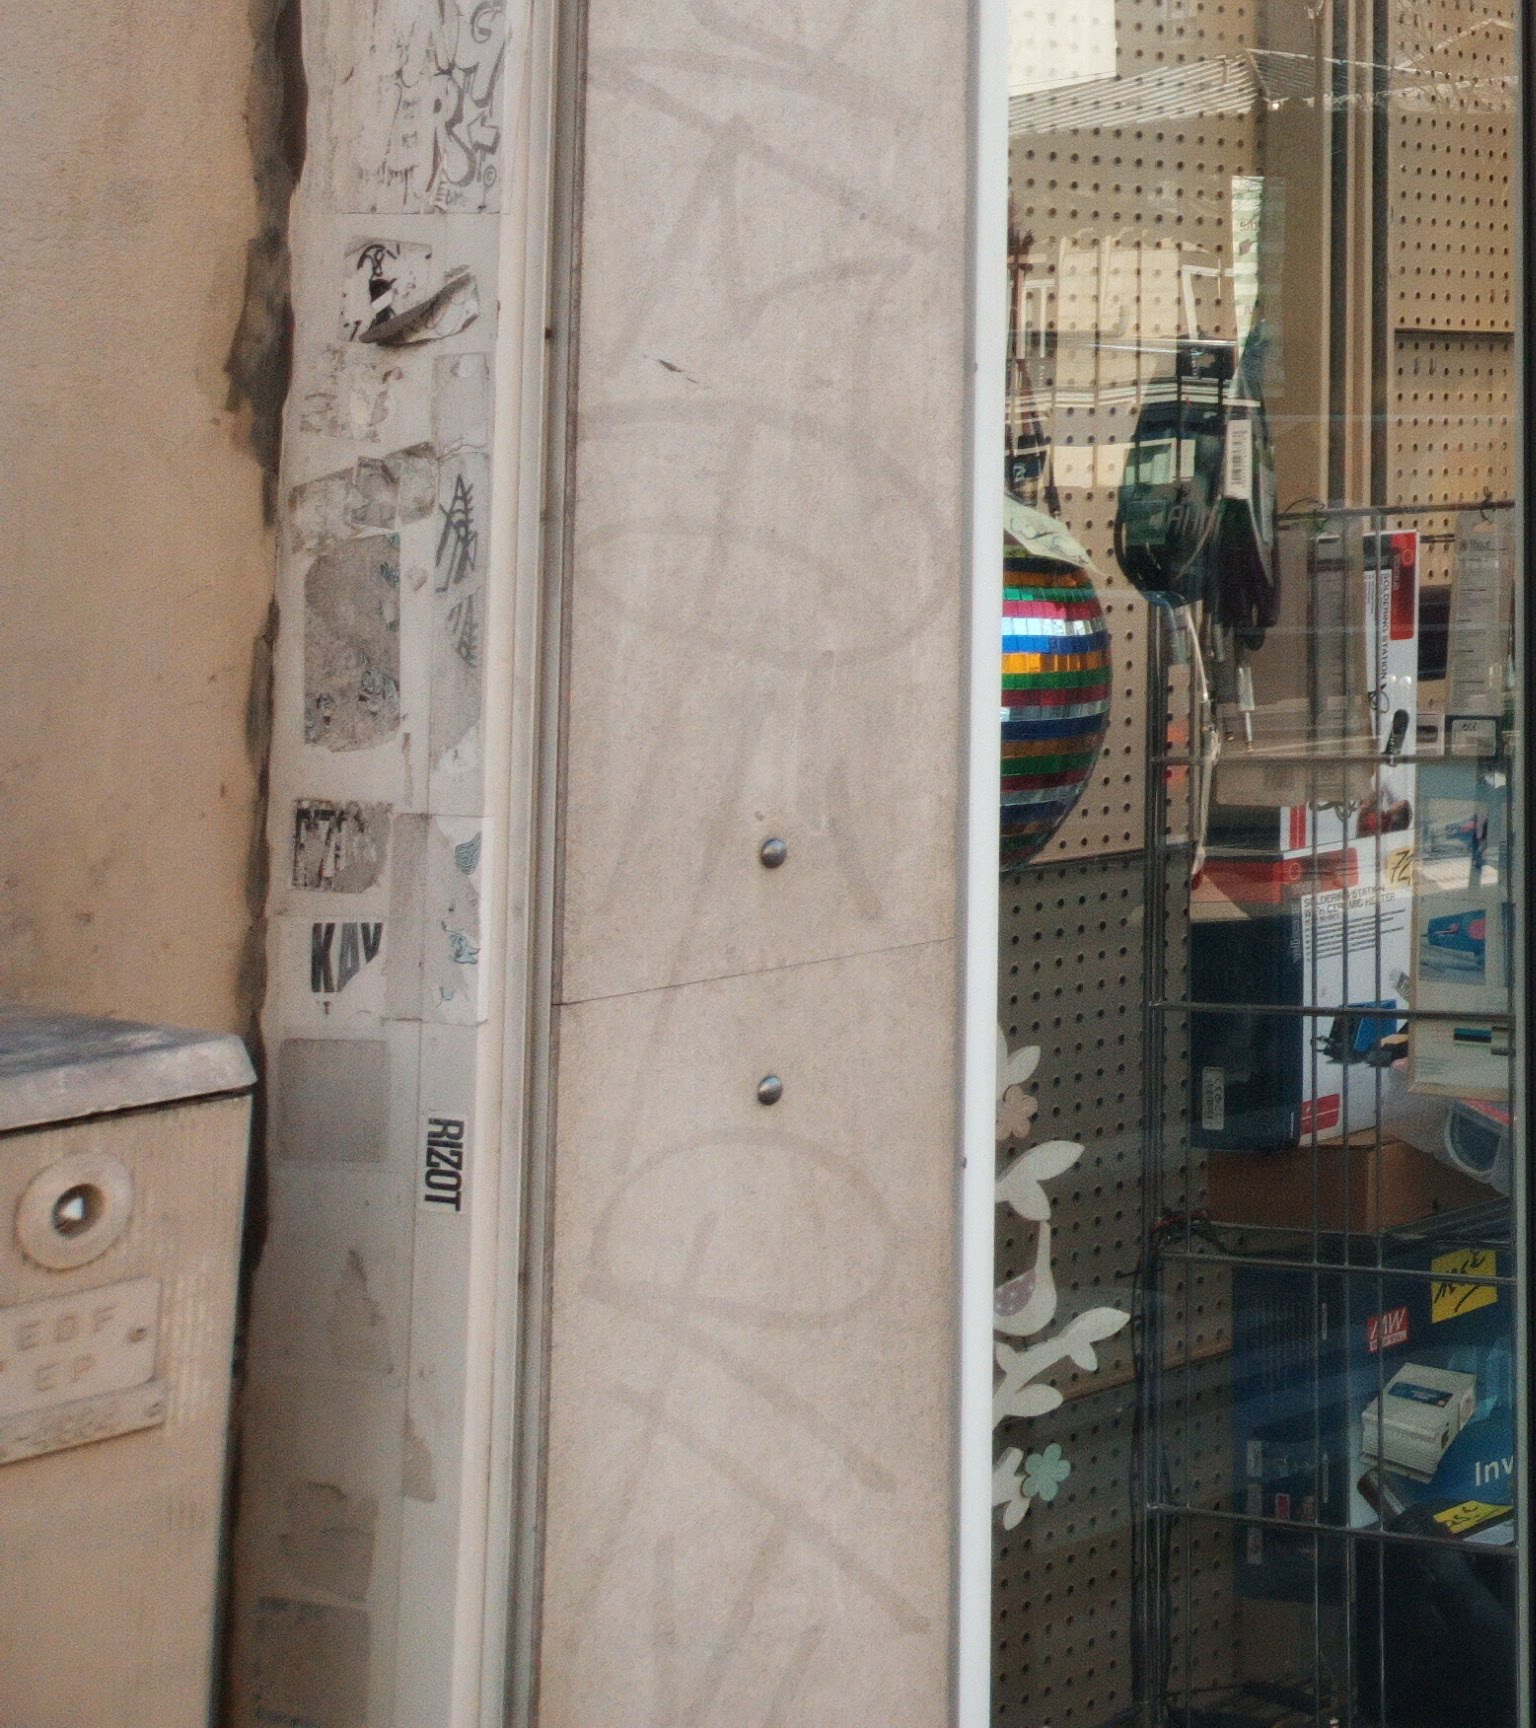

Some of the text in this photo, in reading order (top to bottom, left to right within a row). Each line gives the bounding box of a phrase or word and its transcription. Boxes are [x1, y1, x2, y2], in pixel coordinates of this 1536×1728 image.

[1379, 634, 1390, 681] STATION
[1352, 885, 1386, 899] STATIN
[423, 1117, 466, 1212] RIZOT
